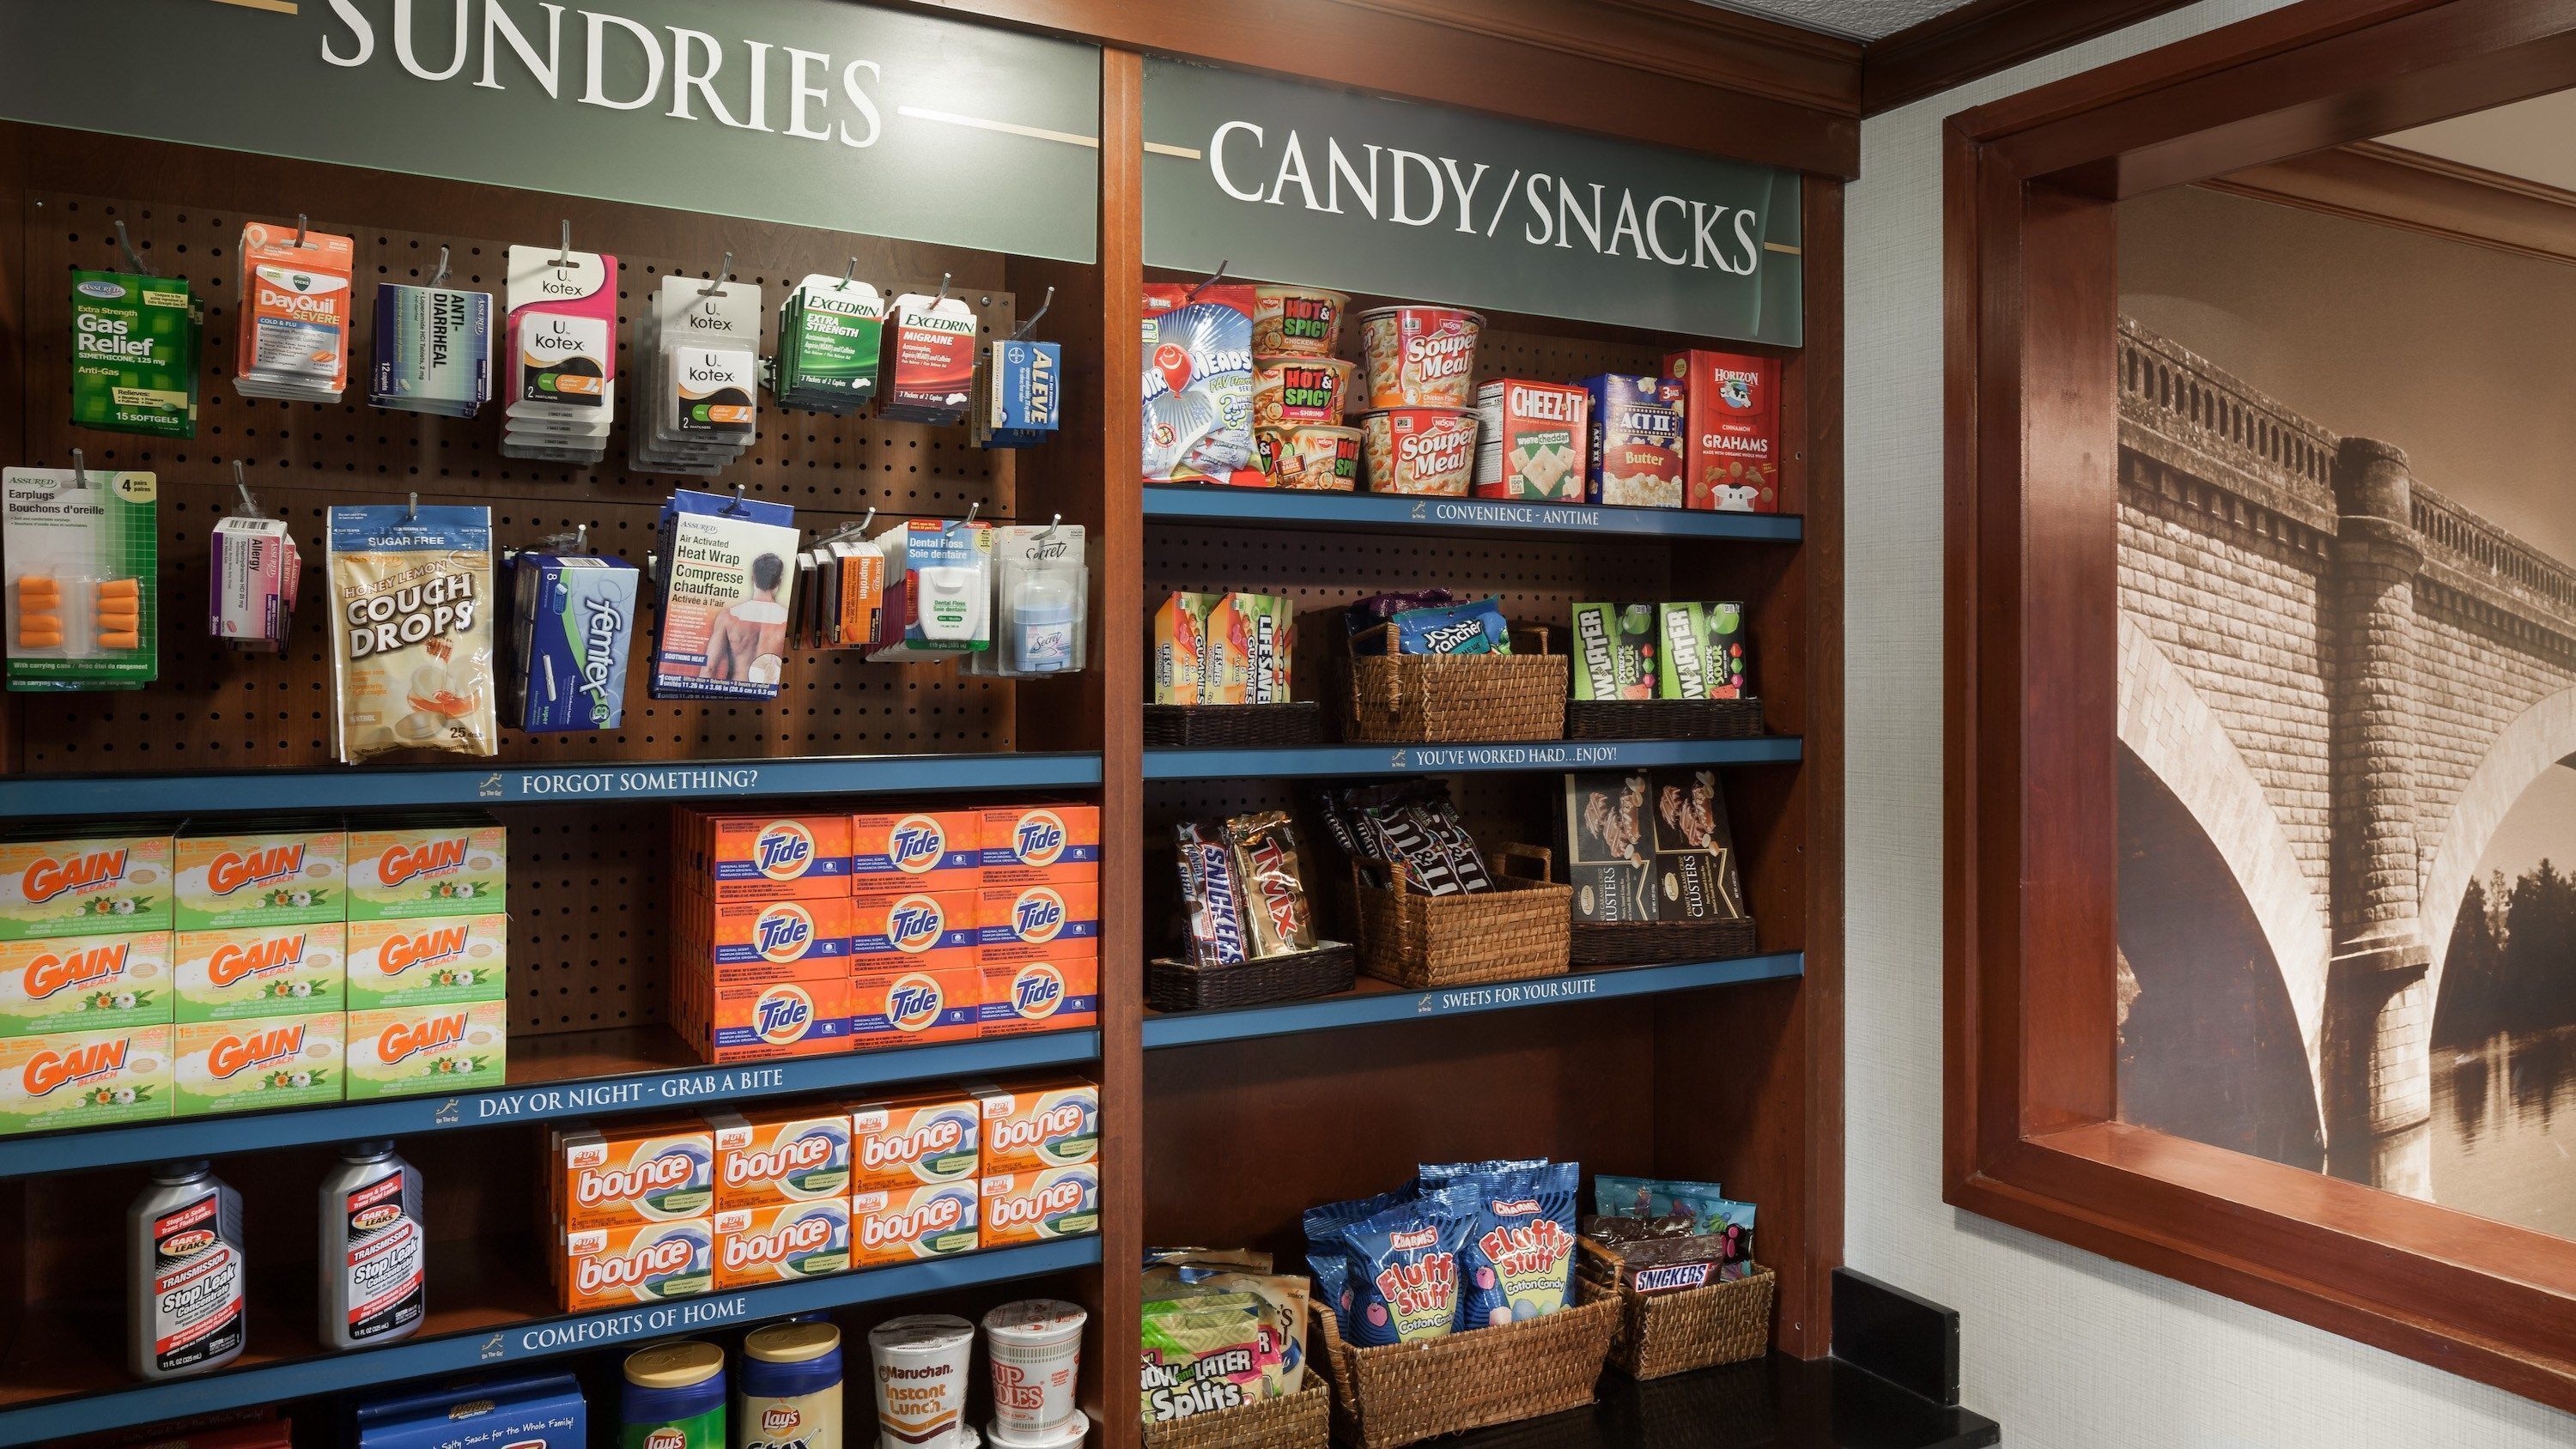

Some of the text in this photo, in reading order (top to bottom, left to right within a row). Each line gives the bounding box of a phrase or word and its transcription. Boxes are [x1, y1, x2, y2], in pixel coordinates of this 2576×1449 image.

[321, 0, 882, 149] SUNDRIES
[1209, 120, 1757, 276] CANDY/SNACKS
[543, 280, 584, 297] kotex
[77, 305, 138, 318] Extra Strength
[260, 288, 336, 314] DayQuil
[807, 295, 879, 318] EXCEDRIN
[1285, 296, 1320, 318] HOT
[76, 312, 129, 335] Gas
[292, 309, 340, 325] SEVERE
[450, 294, 465, 332] ANTI-
[690, 314, 732, 331] kotex
[805, 312, 840, 327] EXTRA
[905, 313, 975, 334] EXCEDRIN
[433, 293, 447, 368] DIARRHEAL
[805, 323, 860, 339] STRENGTH
[902, 330, 954, 346] MIGRAINE
[1284, 318, 1328, 338] SPICY
[77, 332, 155, 356] Relief
[535, 333, 585, 352] kotex
[1406, 333, 1476, 365] Souper
[77, 366, 120, 376] Anti-Gas
[137, 356, 152, 365] 125
[153, 358, 166, 367] mg
[1419, 355, 1469, 385] Meal
[689, 367, 734, 383] kotex
[1031, 347, 1053, 425] ALEVE
[1286, 367, 1321, 389] HOT
[1715, 367, 1759, 386] HORIZON
[118, 389, 150, 397] Relieves:
[1284, 390, 1332, 408] SPICY
[115, 411, 179, 424] 15 SOFTGELS
[1299, 409, 1325, 418] SHRIMP
[1619, 411, 1650, 431] ACT
[1399, 429, 1476, 463] Souper
[1538, 432, 1570, 445] cheddar
[1702, 433, 1768, 452] GRAHAMS
[1411, 451, 1465, 481] Meal
[1625, 450, 1664, 467] Butter
[9, 489, 55, 501] Earplugs
[122, 479, 131, 492] 4
[9, 503, 105, 516] Bouchons d'oreille
[1437, 504, 1599, 526] CONVENIENCE ANYTIME
[368, 536, 445, 547] SUGAR FREE
[679, 534, 730, 549] Air Activated
[909, 537, 964, 549] Dental Floss
[249, 538, 264, 573] Allergy
[677, 545, 740, 567] Heat Wrap
[908, 549, 968, 560] Soie dentaire
[343, 560, 447, 598] HONEY LEMON
[547, 573, 558, 581] 8
[676, 564, 744, 585] Compresse
[860, 558, 870, 600] Ibuprofen
[345, 571, 474, 627] COUGH
[671, 593, 702, 604] Activée
[710, 598, 725, 608] l'air
[673, 579, 739, 599] chauffante
[349, 598, 476, 661] DROPS
[664, 652, 704, 663] SOOTHING HEAT
[1194, 634, 1206, 704] GUMMIES
[1245, 634, 1256, 704] GUMMIES
[1625, 644, 1635, 685] SOUR
[1713, 644, 1722, 685] SOUR
[449, 726, 466, 738] 25
[1417, 749, 1465, 765] YOU'VE
[1468, 748, 1526, 764] WORKED
[522, 769, 758, 794] FORGOT SOMETHING?
[759, 834, 810, 871] Tide
[893, 829, 941, 865] Tide
[1018, 824, 1063, 860] Tide
[208, 842, 306, 896] GAIN
[378, 836, 469, 888] GAIN
[22, 848, 129, 904] GAIN
[1684, 855, 1704, 919] CLUSTERS
[1205, 845, 1245, 964] SNICKERS
[891, 908, 939, 944] Tide
[23, 942, 130, 1000] GAIN
[258, 964, 295, 980] BLEACH
[1443, 979, 1596, 1009] SWEETS FOR YOUR SUITE
[478, 1068, 783, 1119] DAY OR NIGHT GRAB A BITE
[991, 1105, 1084, 1153] bounce
[862, 1119, 962, 1170] bounce
[724, 1136, 832, 1186] bounce
[578, 1155, 693, 1207] bounce
[1494, 1200, 1540, 1216] CHARMS
[365, 1213, 393, 1227] LEAKS
[170, 1232, 203, 1247] BAR'S
[173, 1240, 207, 1253] LEAKS
[353, 1226, 410, 1262] TRANSMISSION
[1479, 1219, 1575, 1264] Fluffy
[161, 1252, 226, 1289] TRANSMISSION
[1501, 1247, 1555, 1277] Stuff
[162, 1262, 237, 1314] Stop Leak
[1637, 1264, 1707, 1291] SNICKERS
[176, 1282, 231, 1319] Concentrate
[1396, 1282, 1451, 1317] Stuff
[522, 1297, 746, 1351] COMFORTS OF HOME
[888, 1364, 951, 1379] Maruchan
[1194, 1349, 1252, 1382] LATER
[888, 1399, 941, 1416] Lunch
[1151, 1381, 1242, 1422] Splits
[465, 1416, 574, 1446] Snack for the Whole Family!
[763, 1410, 799, 1430] Lay's
